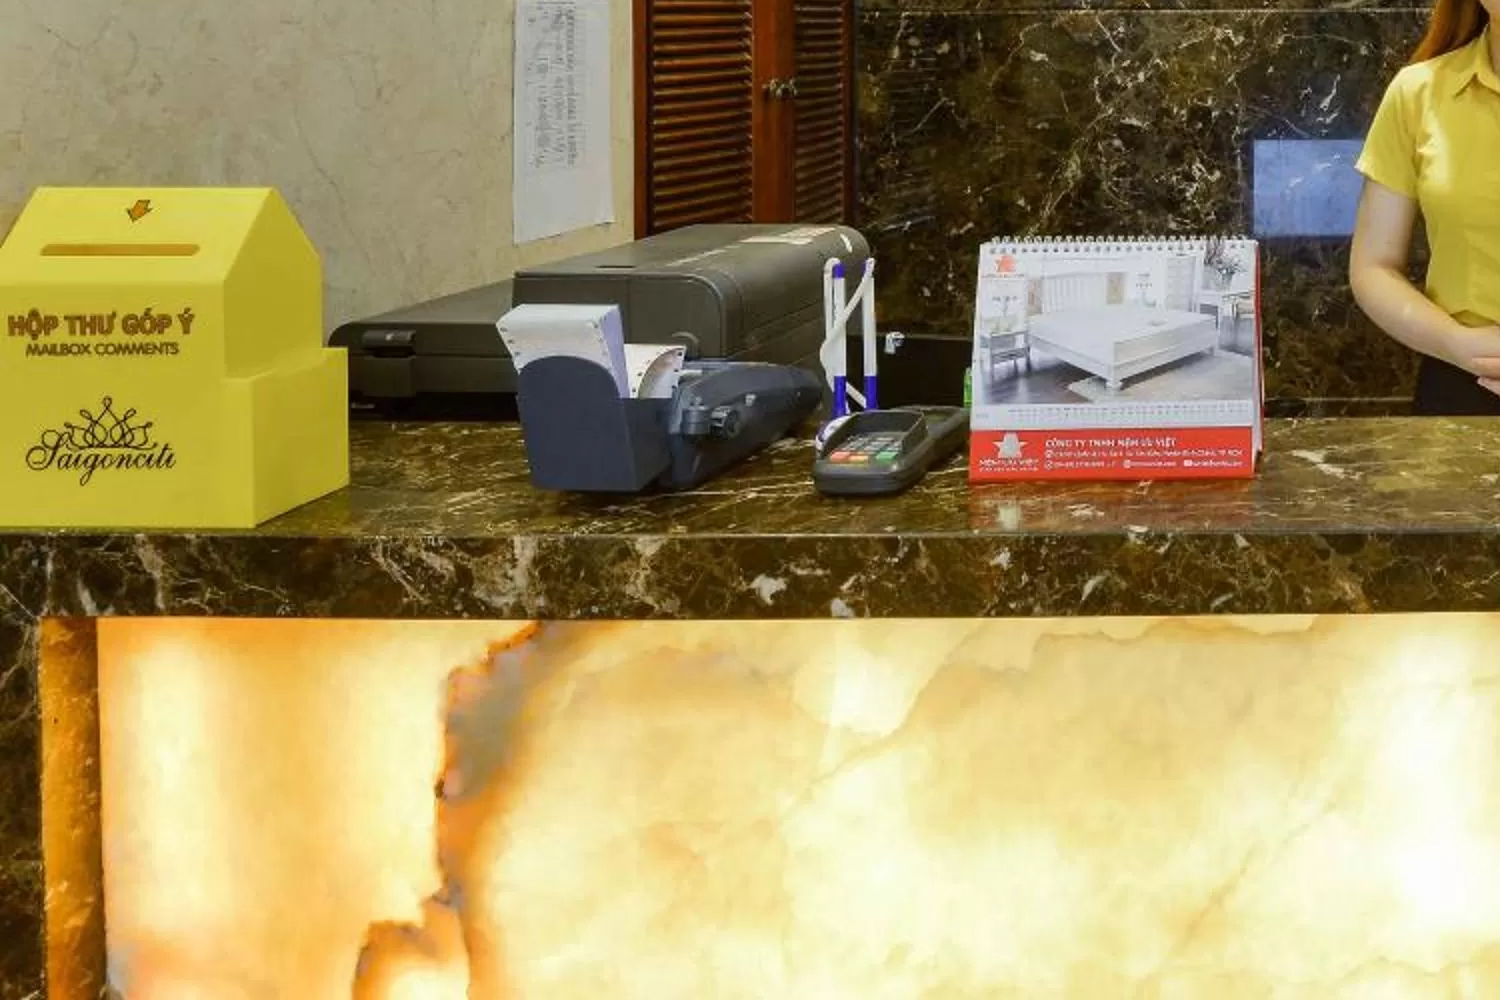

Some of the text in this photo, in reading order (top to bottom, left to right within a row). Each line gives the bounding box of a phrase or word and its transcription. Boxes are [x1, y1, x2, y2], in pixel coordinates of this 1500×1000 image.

[8, 307, 195, 340] HỘP THƯ GÓP Ý
[25, 341, 180, 358] MAILBOX COMMENTS
